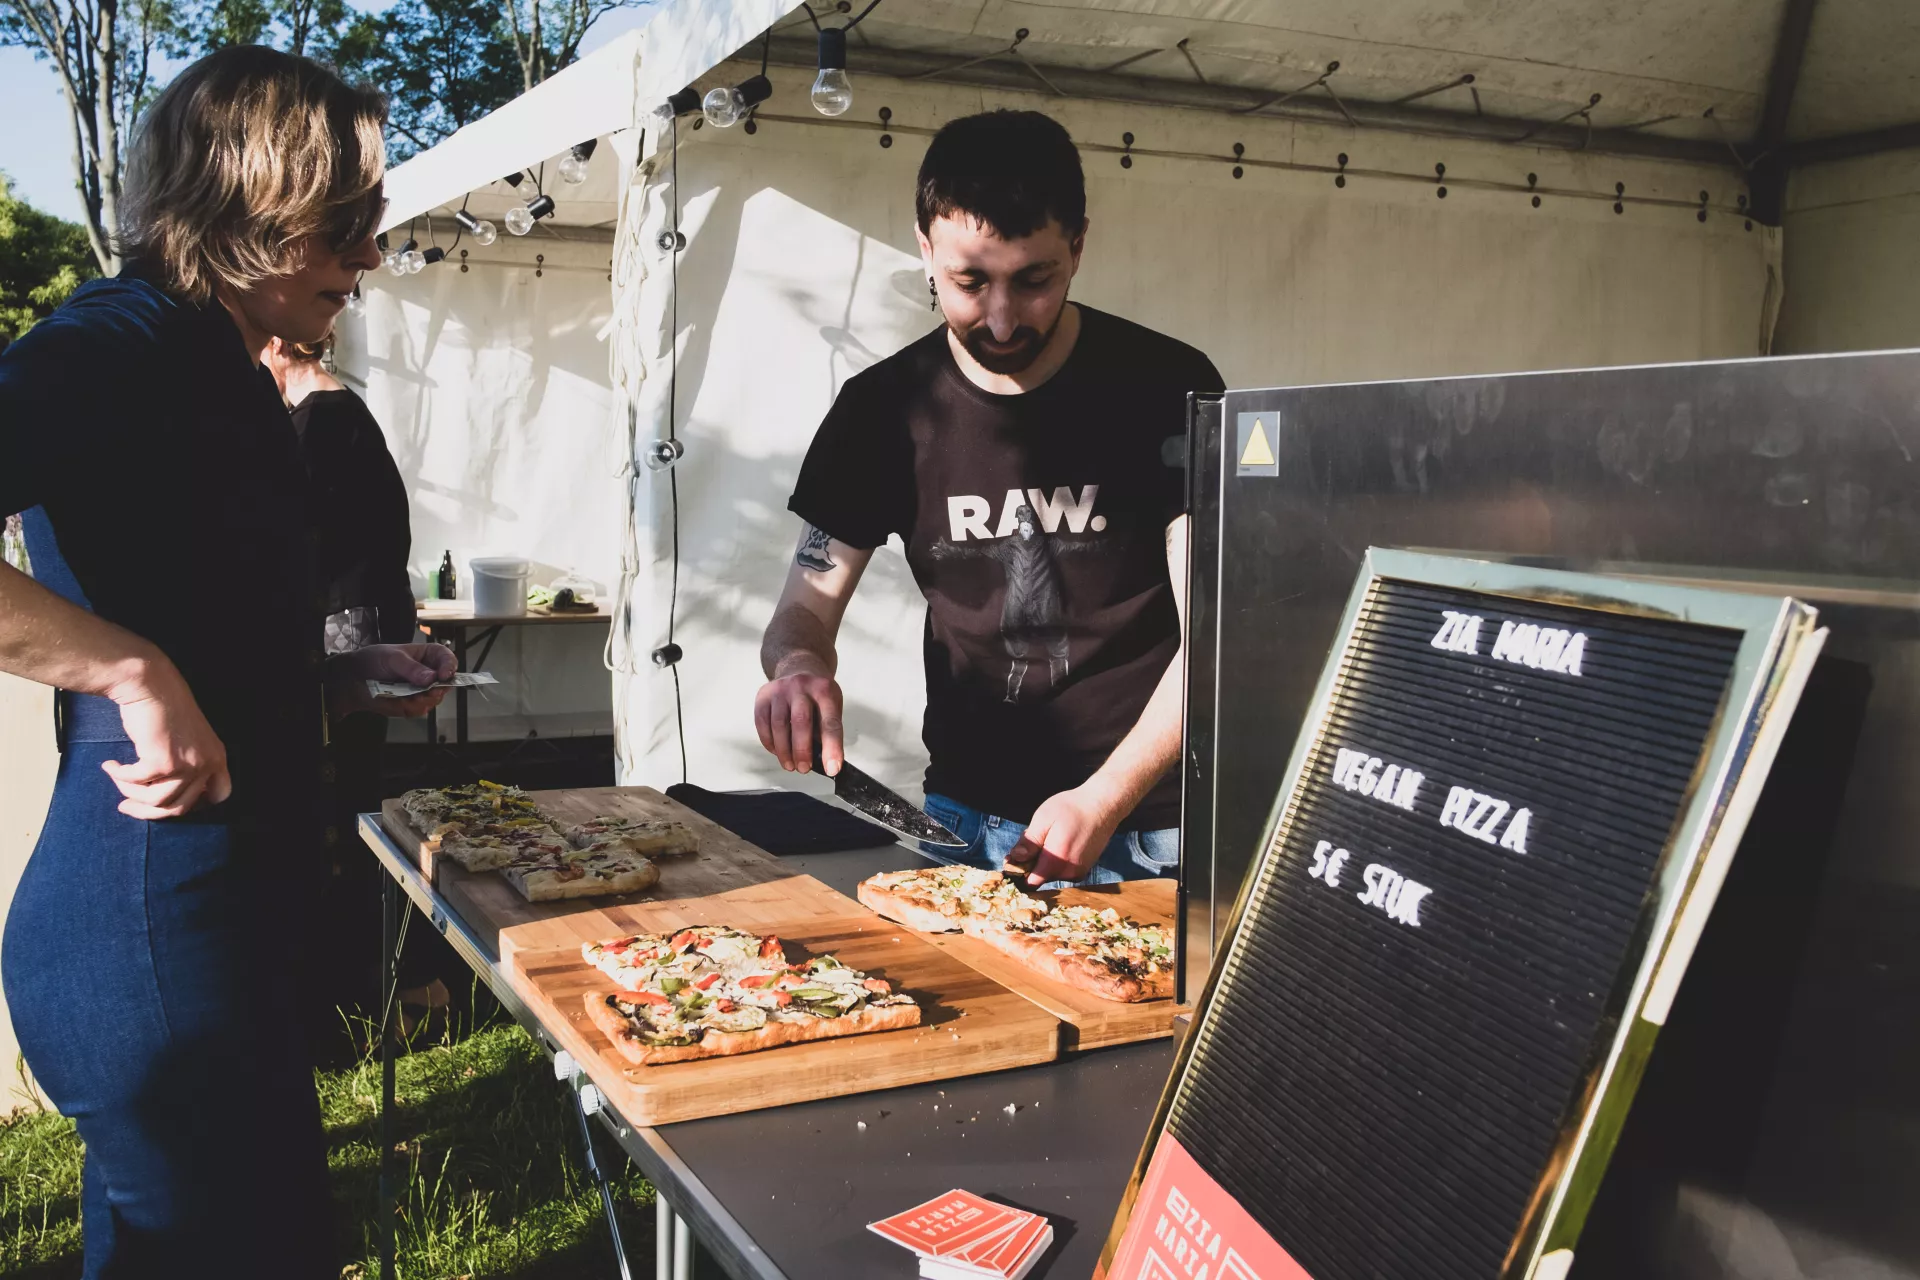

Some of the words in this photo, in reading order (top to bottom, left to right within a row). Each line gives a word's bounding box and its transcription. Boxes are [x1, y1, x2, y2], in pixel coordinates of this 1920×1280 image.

[947, 484, 1107, 542] RAW.
[1431, 611, 1484, 655] ZIA
[1491, 620, 1588, 676] MARIA
[1332, 748, 1425, 811] VEGAN
[1439, 786, 1533, 854] PIZZA
[1308, 840, 1350, 888] 5€
[1357, 863, 1433, 927] STUK
[1184, 1207, 1221, 1260] ZIA
